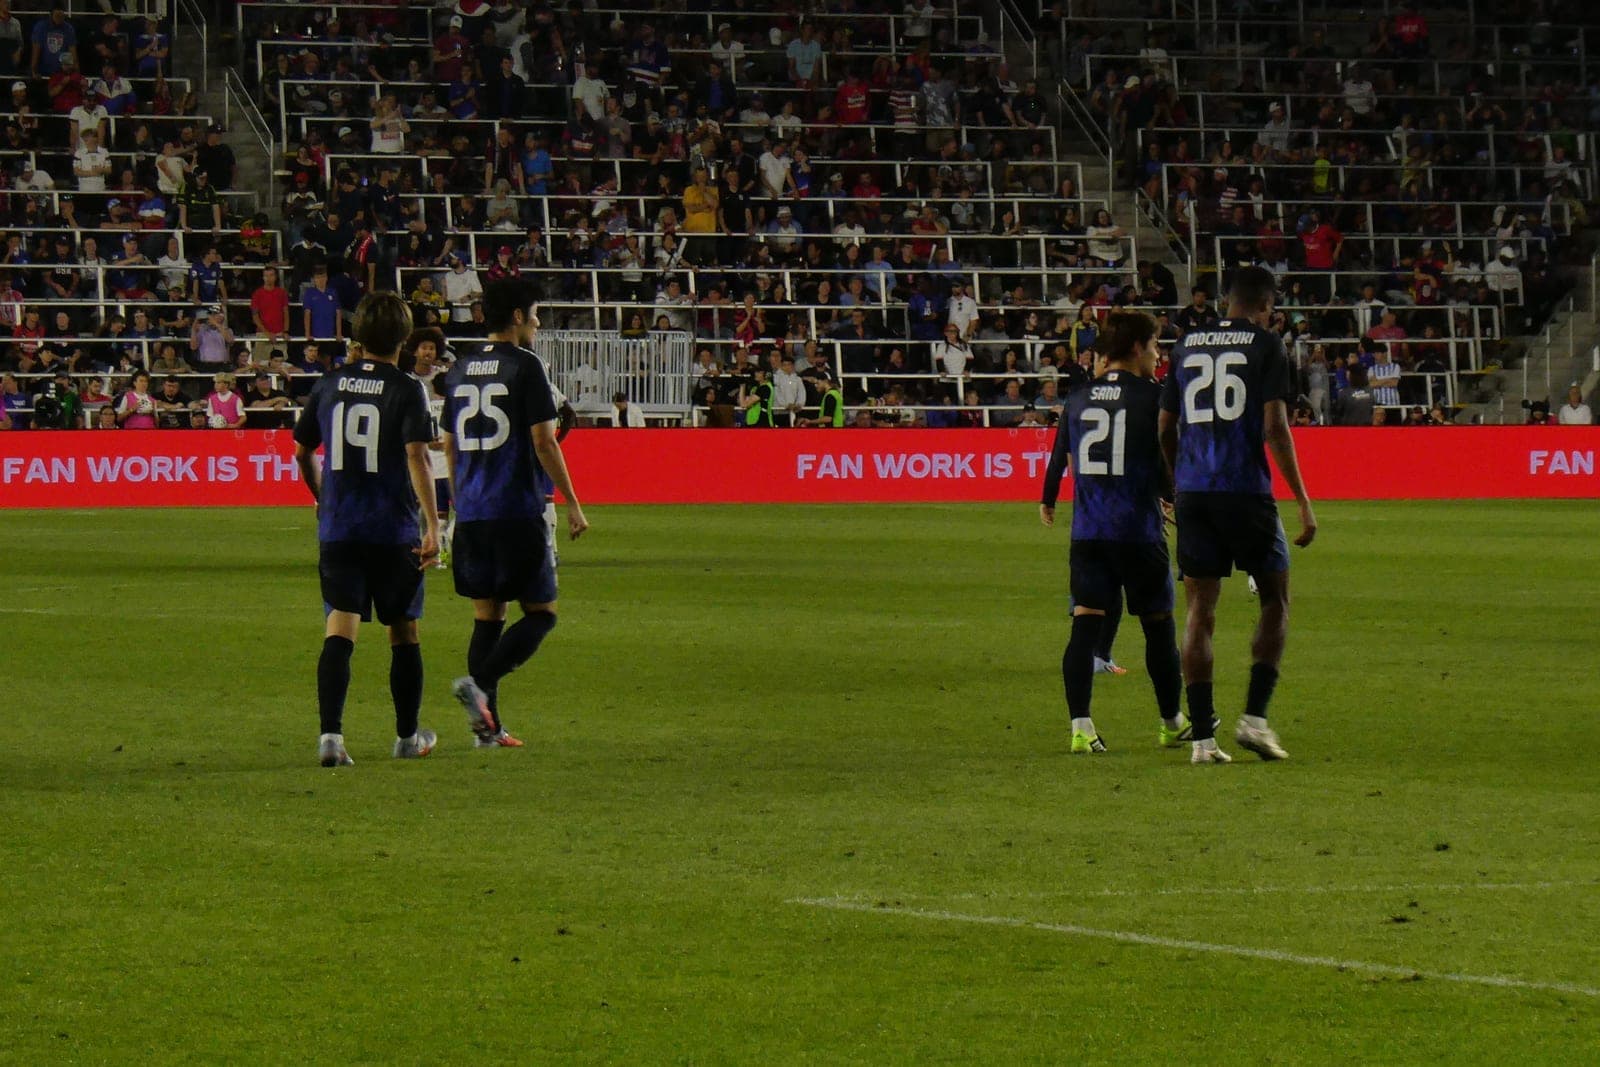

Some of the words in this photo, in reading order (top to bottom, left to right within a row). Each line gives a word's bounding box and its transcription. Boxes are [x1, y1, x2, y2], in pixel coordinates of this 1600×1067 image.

[1184, 331, 1256, 348] MOCHIZUKI
[466, 359, 499, 376] ARAKI
[337, 376, 385, 395] OGAWA
[1089, 385, 1122, 401] SANO
[1182, 351, 1248, 425] 26
[453, 382, 511, 452] 25
[331, 401, 380, 473] 19
[1078, 408, 1127, 476] 21
[3, 457, 76, 484] FAN
[87, 456, 199, 483] WORK
[208, 455, 239, 482] IS
[248, 454, 299, 482] TH
[797, 454, 863, 479] FAN
[873, 453, 977, 479] WORK
[985, 452, 1013, 478] IS
[1529, 450, 1594, 475] FAN
